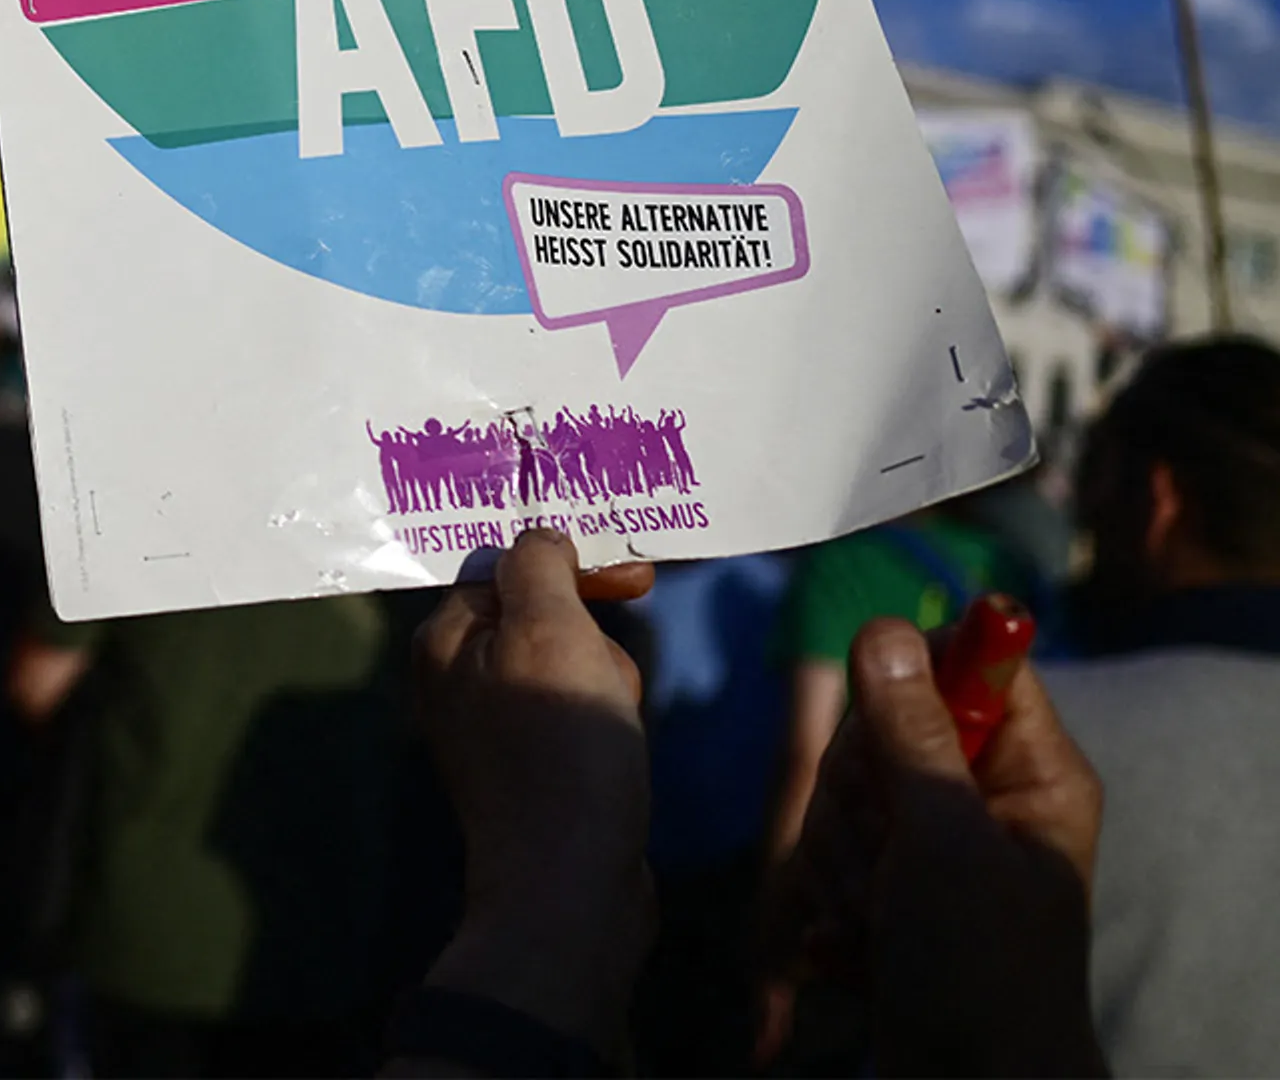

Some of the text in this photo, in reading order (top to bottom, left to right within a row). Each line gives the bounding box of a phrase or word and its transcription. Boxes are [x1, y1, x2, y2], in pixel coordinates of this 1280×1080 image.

[530, 197, 770, 233] UNSERE ALTERNATIVE
[533, 233, 773, 269] HEISST SOLIDARITÄT!
